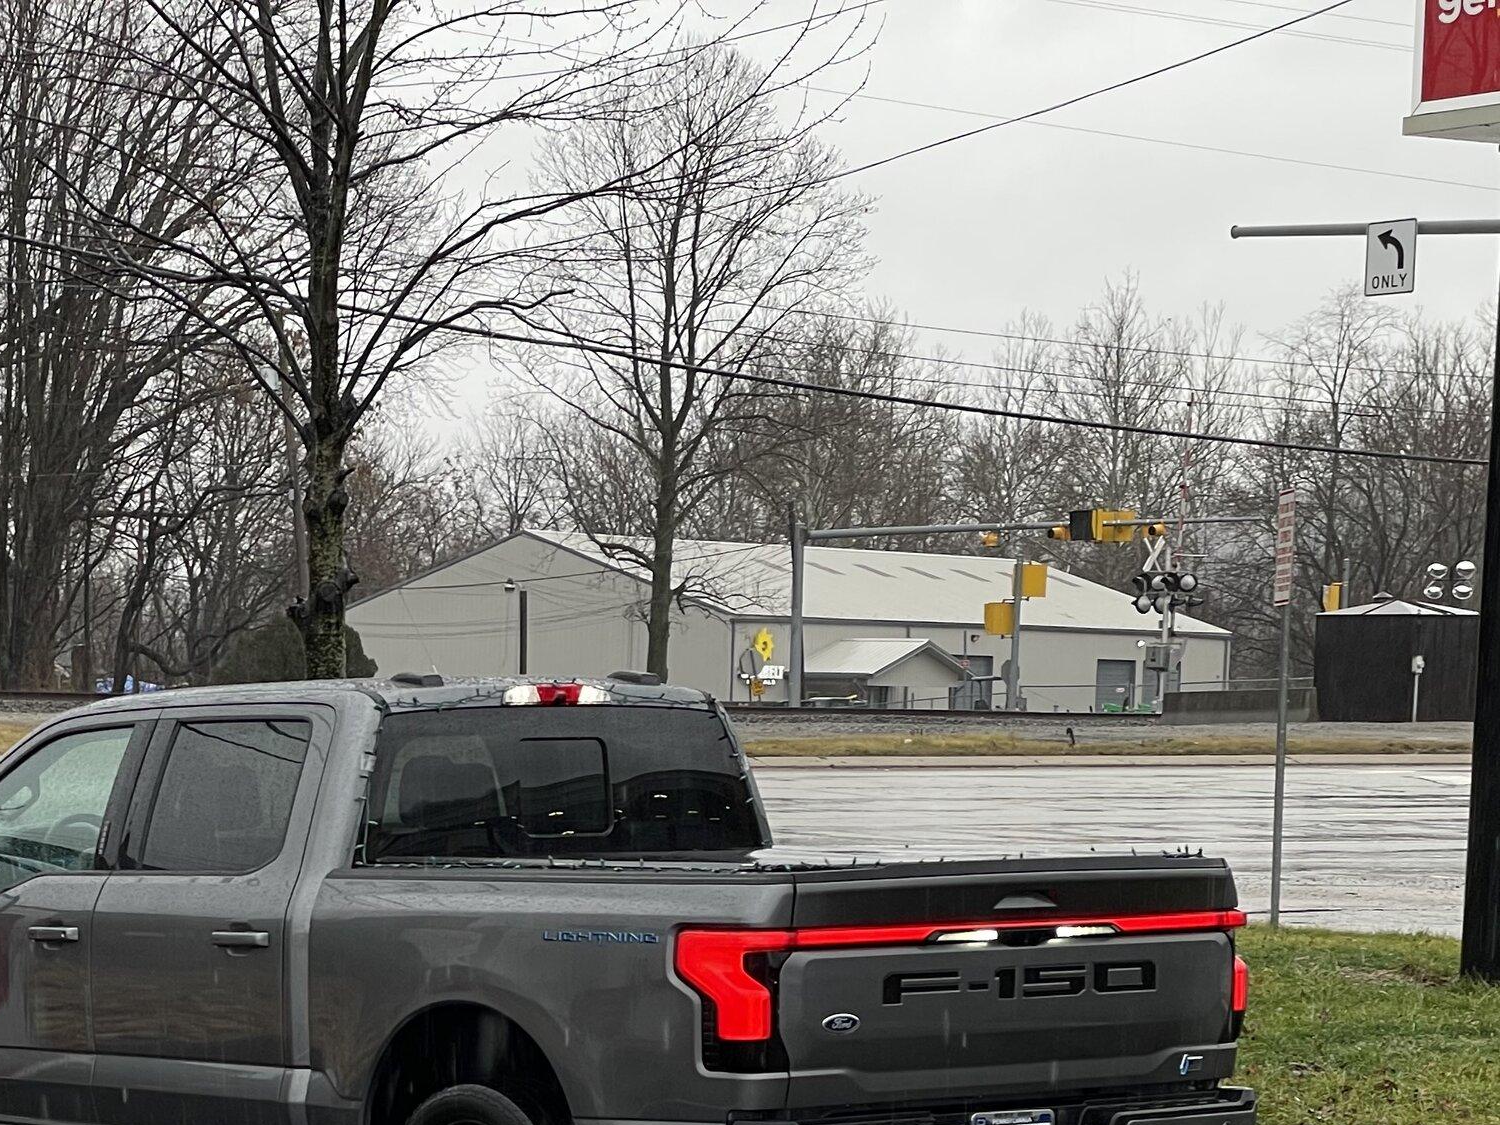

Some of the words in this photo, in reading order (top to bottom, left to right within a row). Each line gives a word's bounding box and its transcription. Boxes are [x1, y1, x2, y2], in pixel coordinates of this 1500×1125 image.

[1371, 272, 1408, 289] ONLY
[543, 930, 660, 945] LIGHTNING
[882, 960, 1156, 1006] F-150
